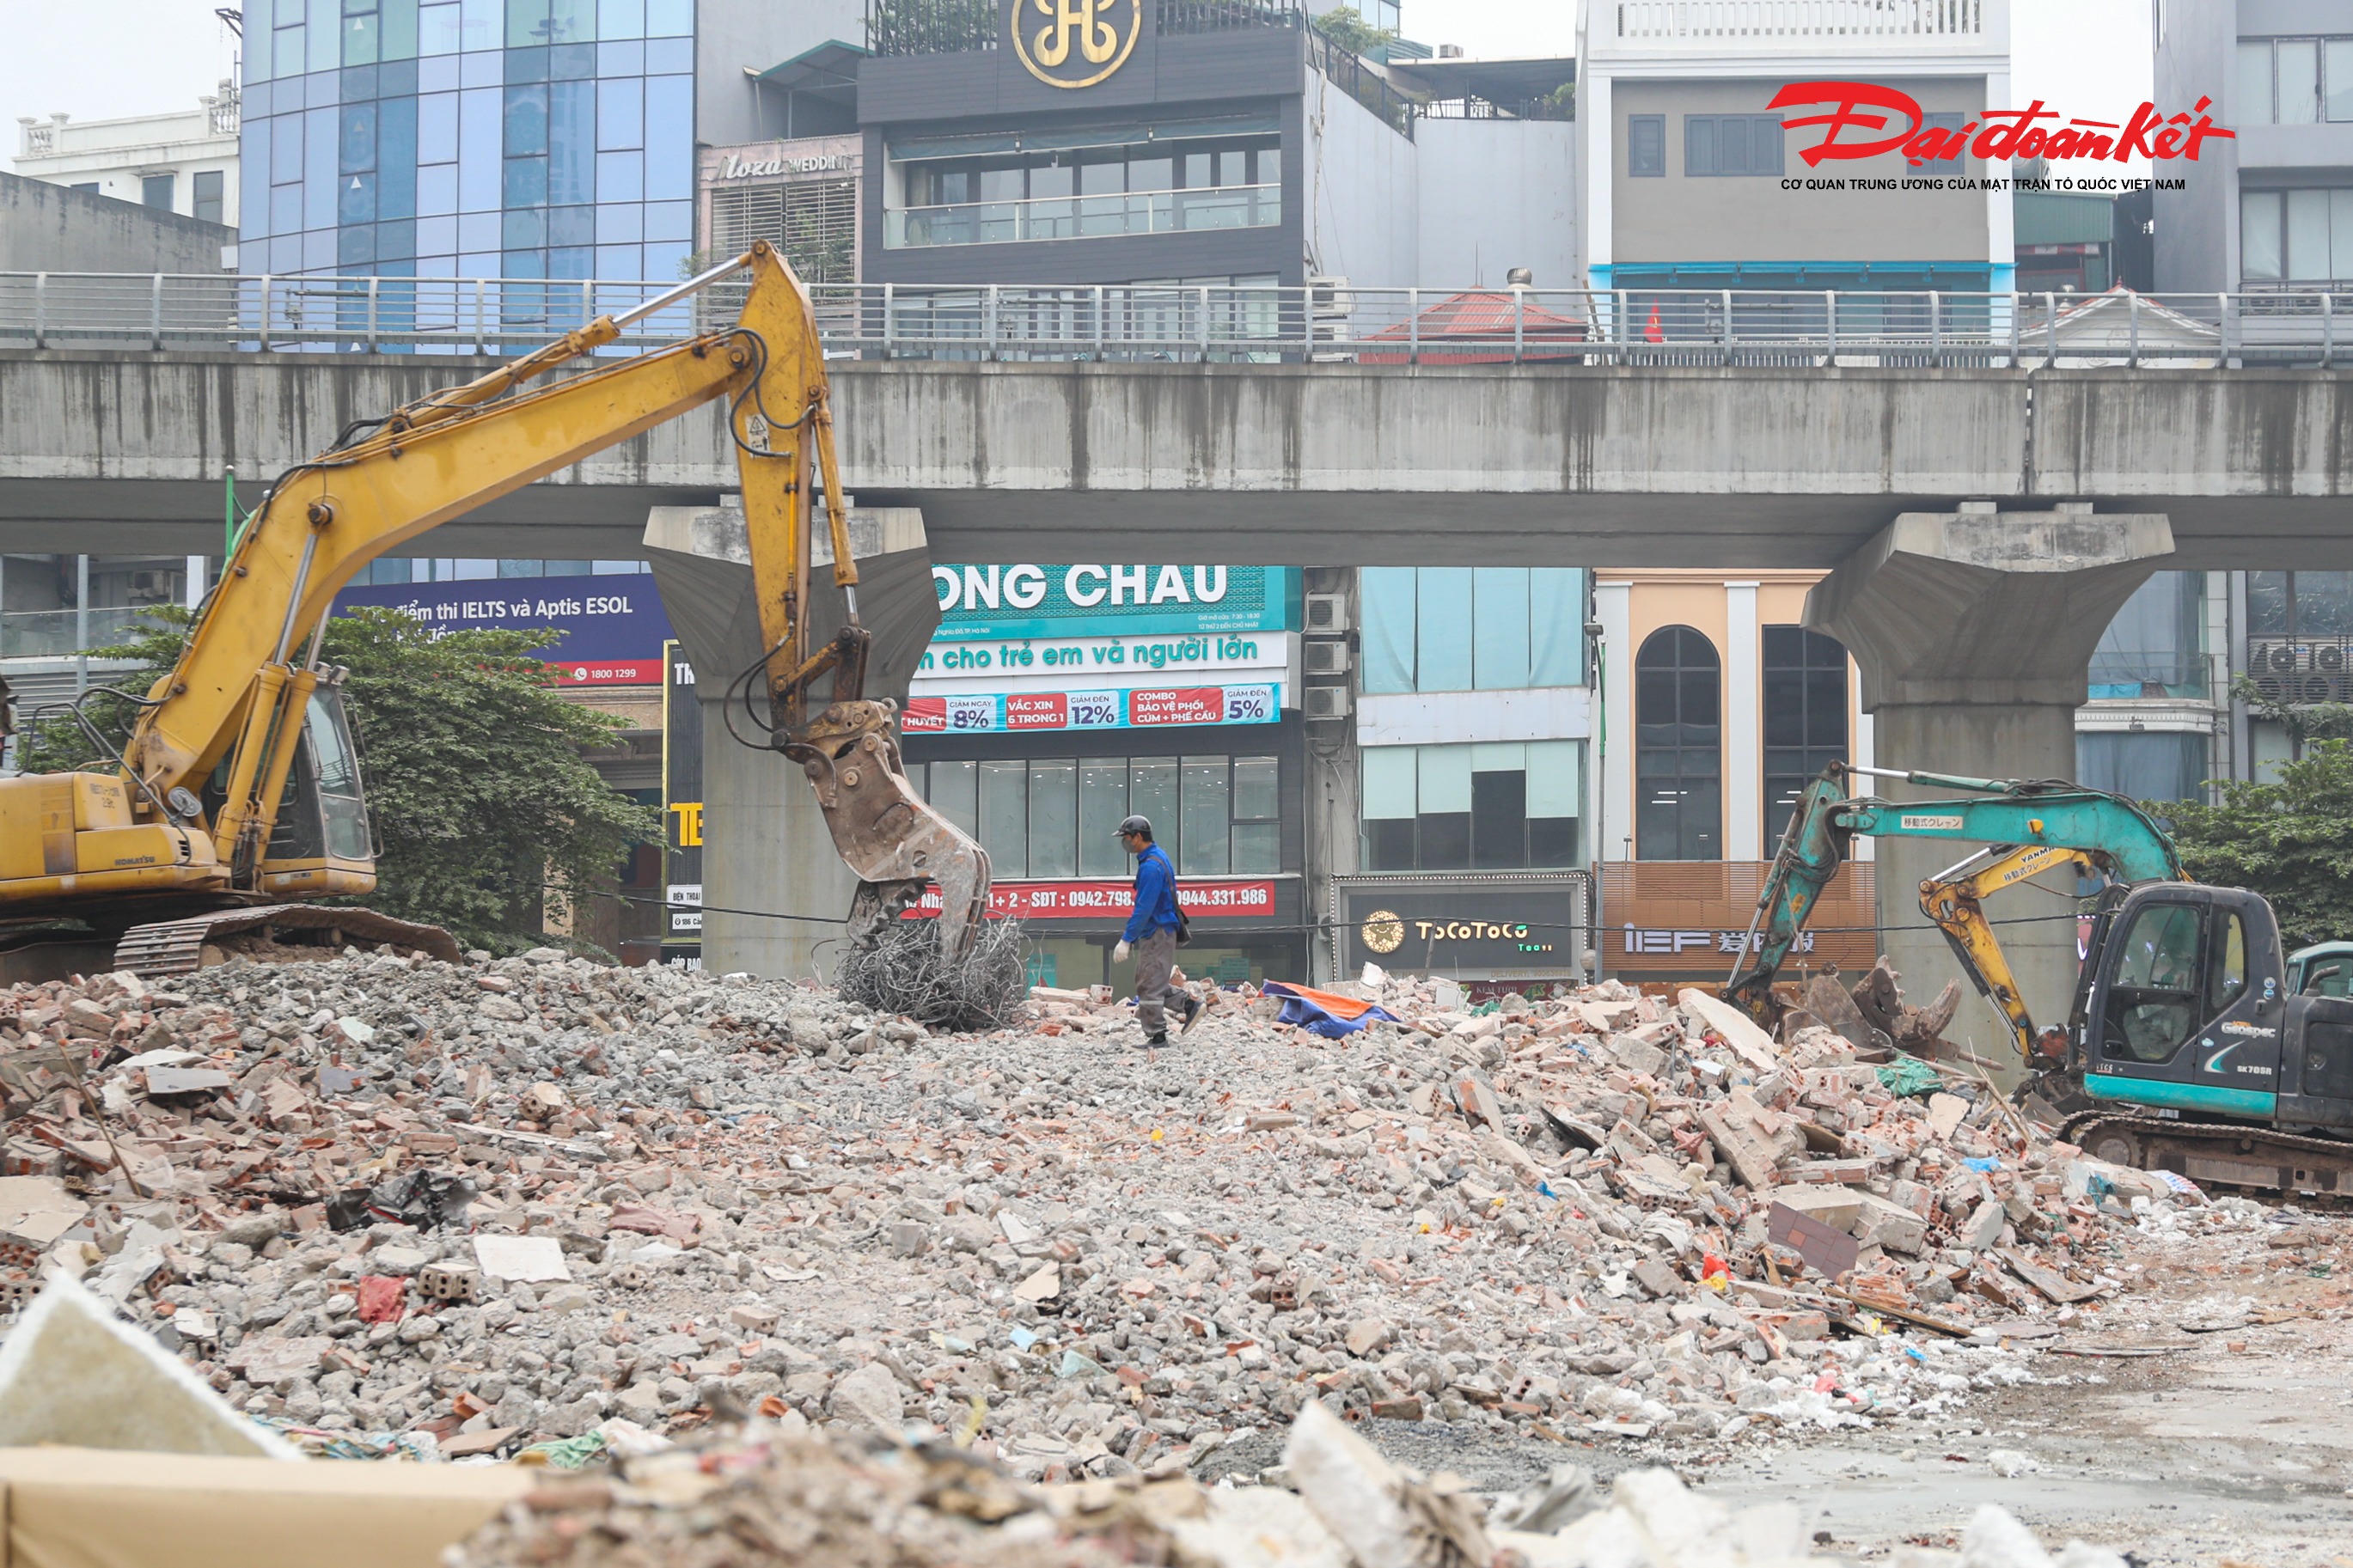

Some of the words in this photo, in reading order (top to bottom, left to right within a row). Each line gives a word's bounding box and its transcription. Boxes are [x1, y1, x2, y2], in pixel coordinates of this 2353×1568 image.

[932, 564, 1047, 611] ONG
[437, 602, 458, 620] thi
[462, 601, 506, 619] IELTS
[510, 599, 531, 617] và
[535, 598, 581, 619] Aptis
[586, 596, 633, 614] ESOL
[942, 646, 992, 668] cho
[999, 640, 1034, 667] trẻ
[1042, 647, 1083, 666] em
[1092, 639, 1125, 664] và
[1134, 637, 1208, 668] người
[1217, 633, 1257, 660] lớn
[590, 669, 613, 679] 1800
[614, 668, 637, 678] 1299
[1007, 699, 1031, 711] VẮC
[1034, 700, 1054, 710] XIN
[1137, 692, 1176, 701] COMBO
[1072, 705, 1115, 724] 12%
[1137, 712, 1160, 723] CÚM
[1170, 711, 1193, 721] PHẾ
[1229, 699, 1264, 719] 5%
[907, 715, 944, 727] HUYẾT
[953, 709, 988, 729] 8%
[1008, 715, 1015, 724] 6
[1018, 714, 1057, 723] TRONG
[1059, 713, 1064, 723] 1
[2021, 846, 2056, 863] YANM
[1009, 892, 1018, 907] 2
[1031, 890, 1057, 907] SĐT
[1068, 890, 1135, 907] 0942.798.
